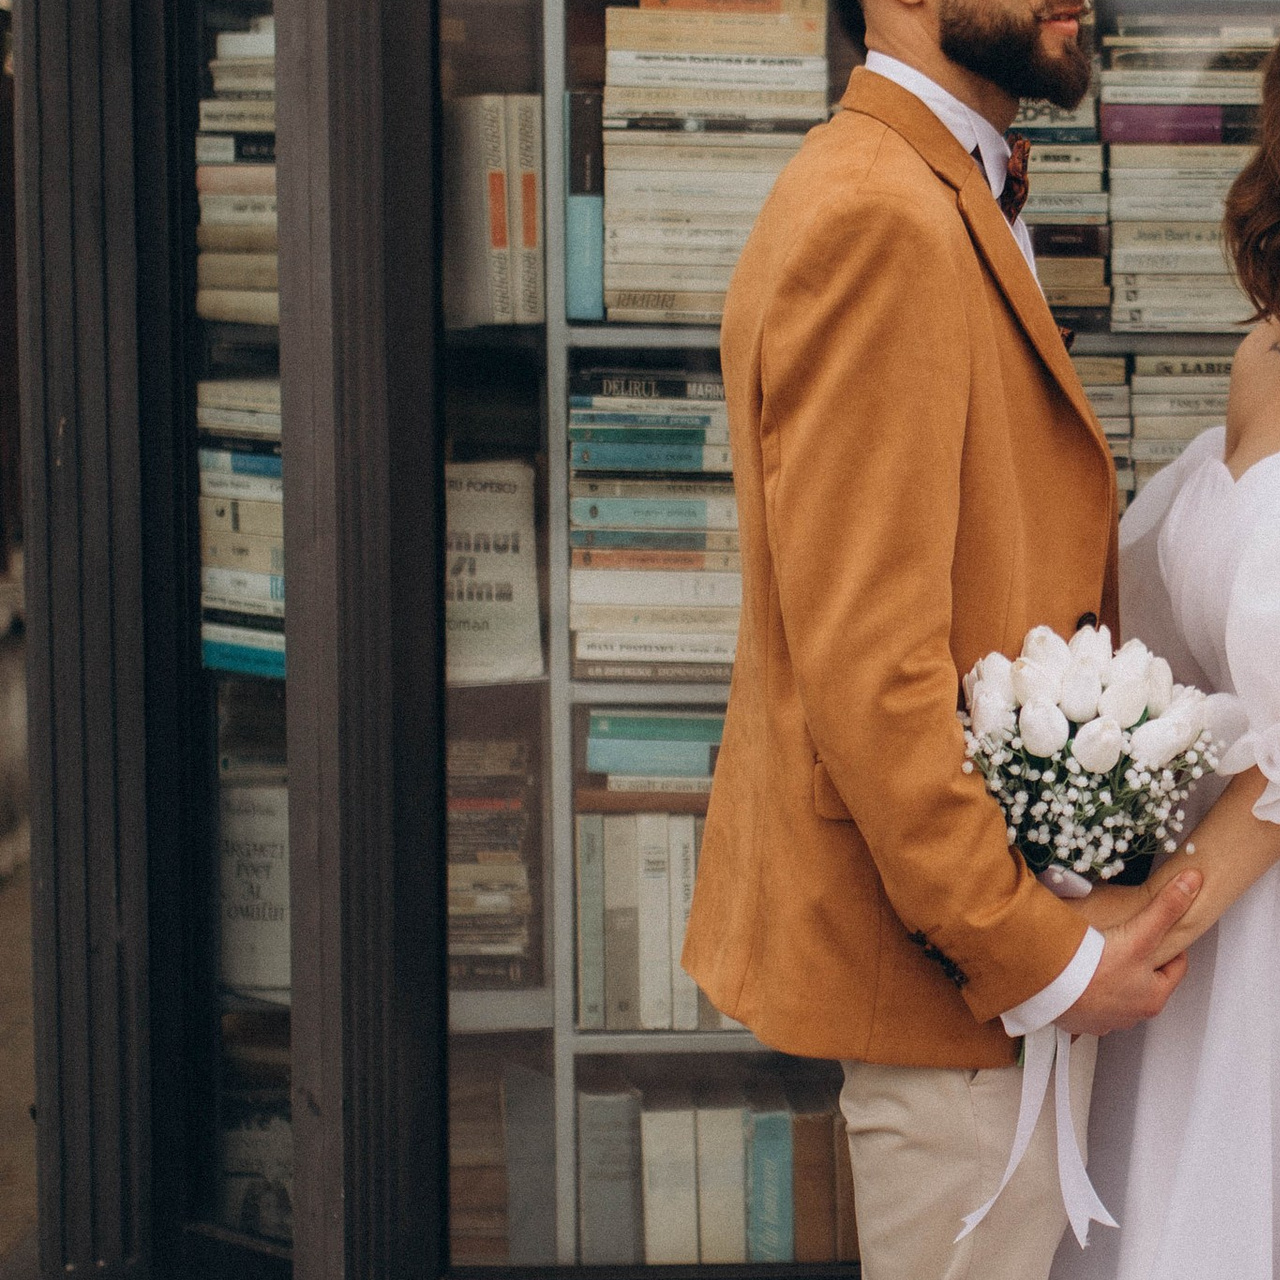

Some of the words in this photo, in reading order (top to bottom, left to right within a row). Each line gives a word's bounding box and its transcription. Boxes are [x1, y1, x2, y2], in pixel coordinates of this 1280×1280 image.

[602, 378, 661, 398] DELIRUL
[686, 381, 725, 399] MARIN
[466, 478, 518, 495] POPESCU
[446, 531, 521, 555] mnul
[447, 619, 490, 634] oman
